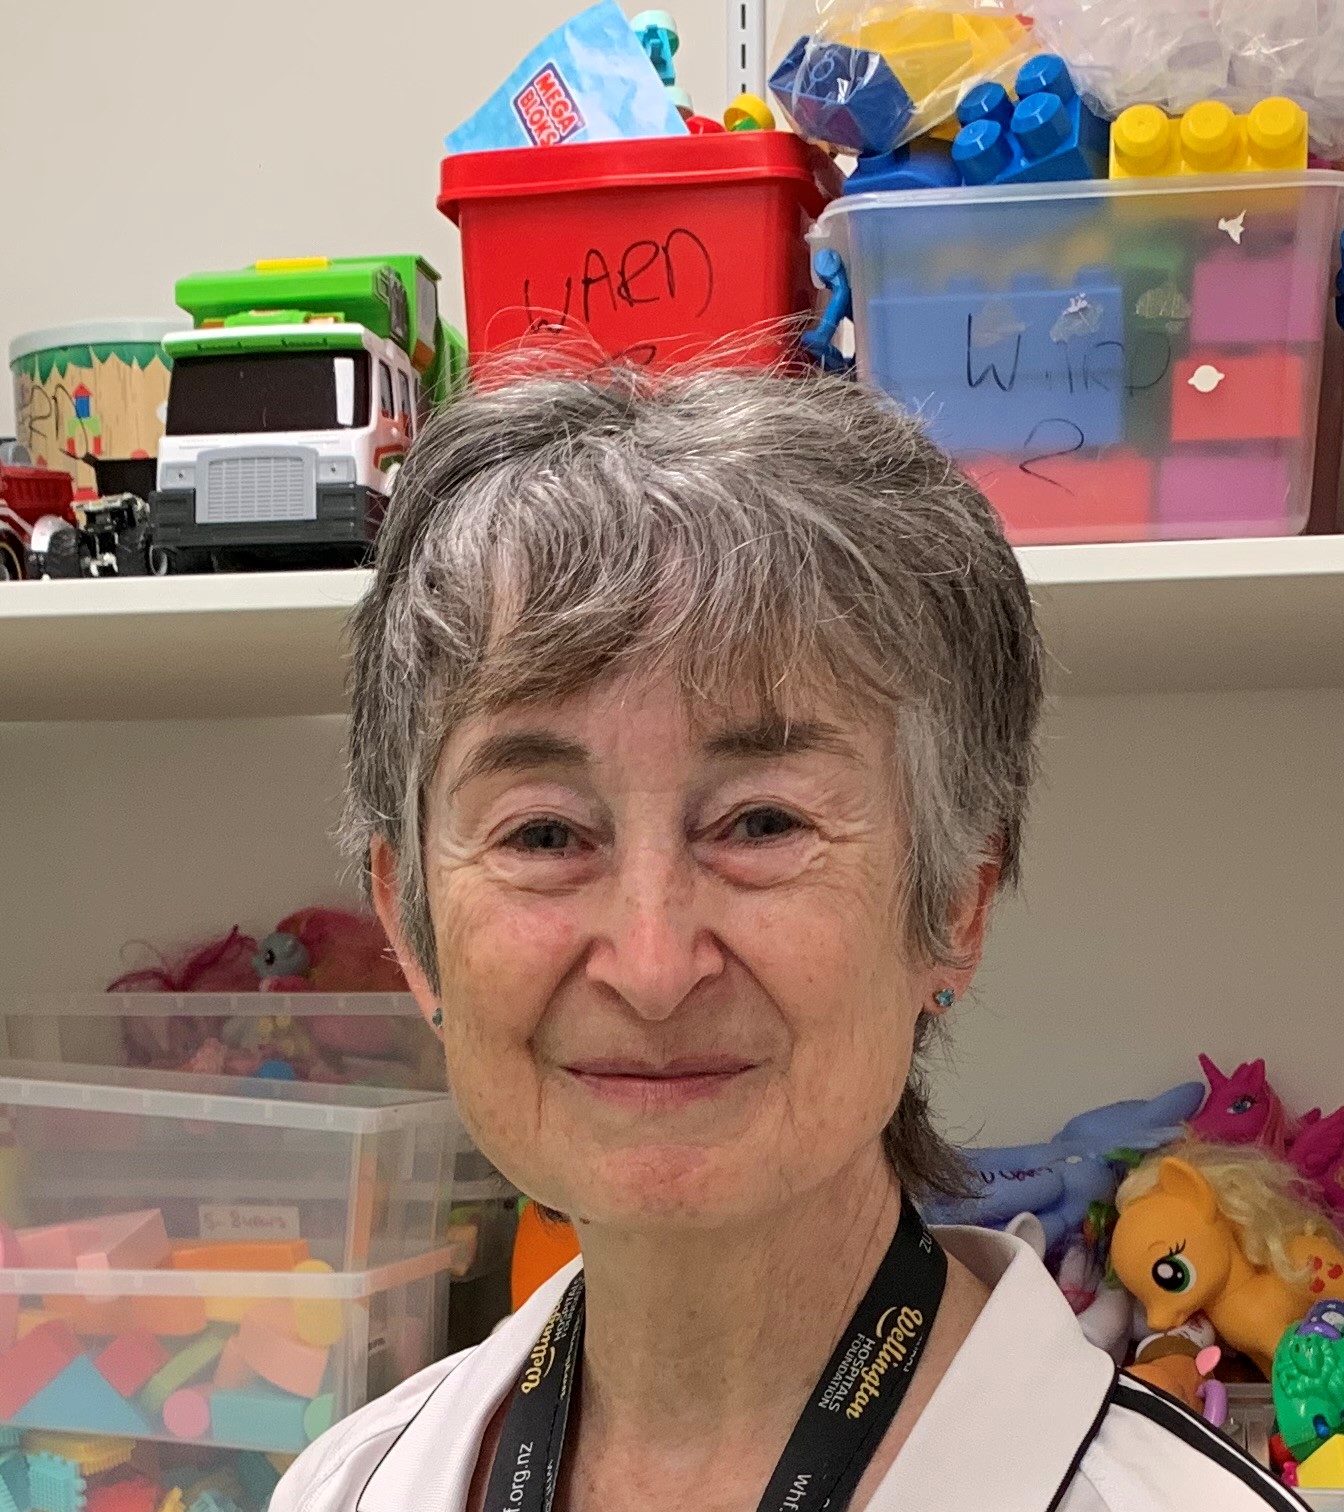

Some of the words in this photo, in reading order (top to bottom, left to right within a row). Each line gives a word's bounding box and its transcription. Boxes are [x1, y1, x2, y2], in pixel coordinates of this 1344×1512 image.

[534, 70, 578, 136] MEGA
[524, 227, 713, 334] WARD
[818, 1332, 866, 1409] FOUNDATION
[828, 1338, 875, 1413] HOSPITALS
[846, 1306, 923, 1420] Wellington
